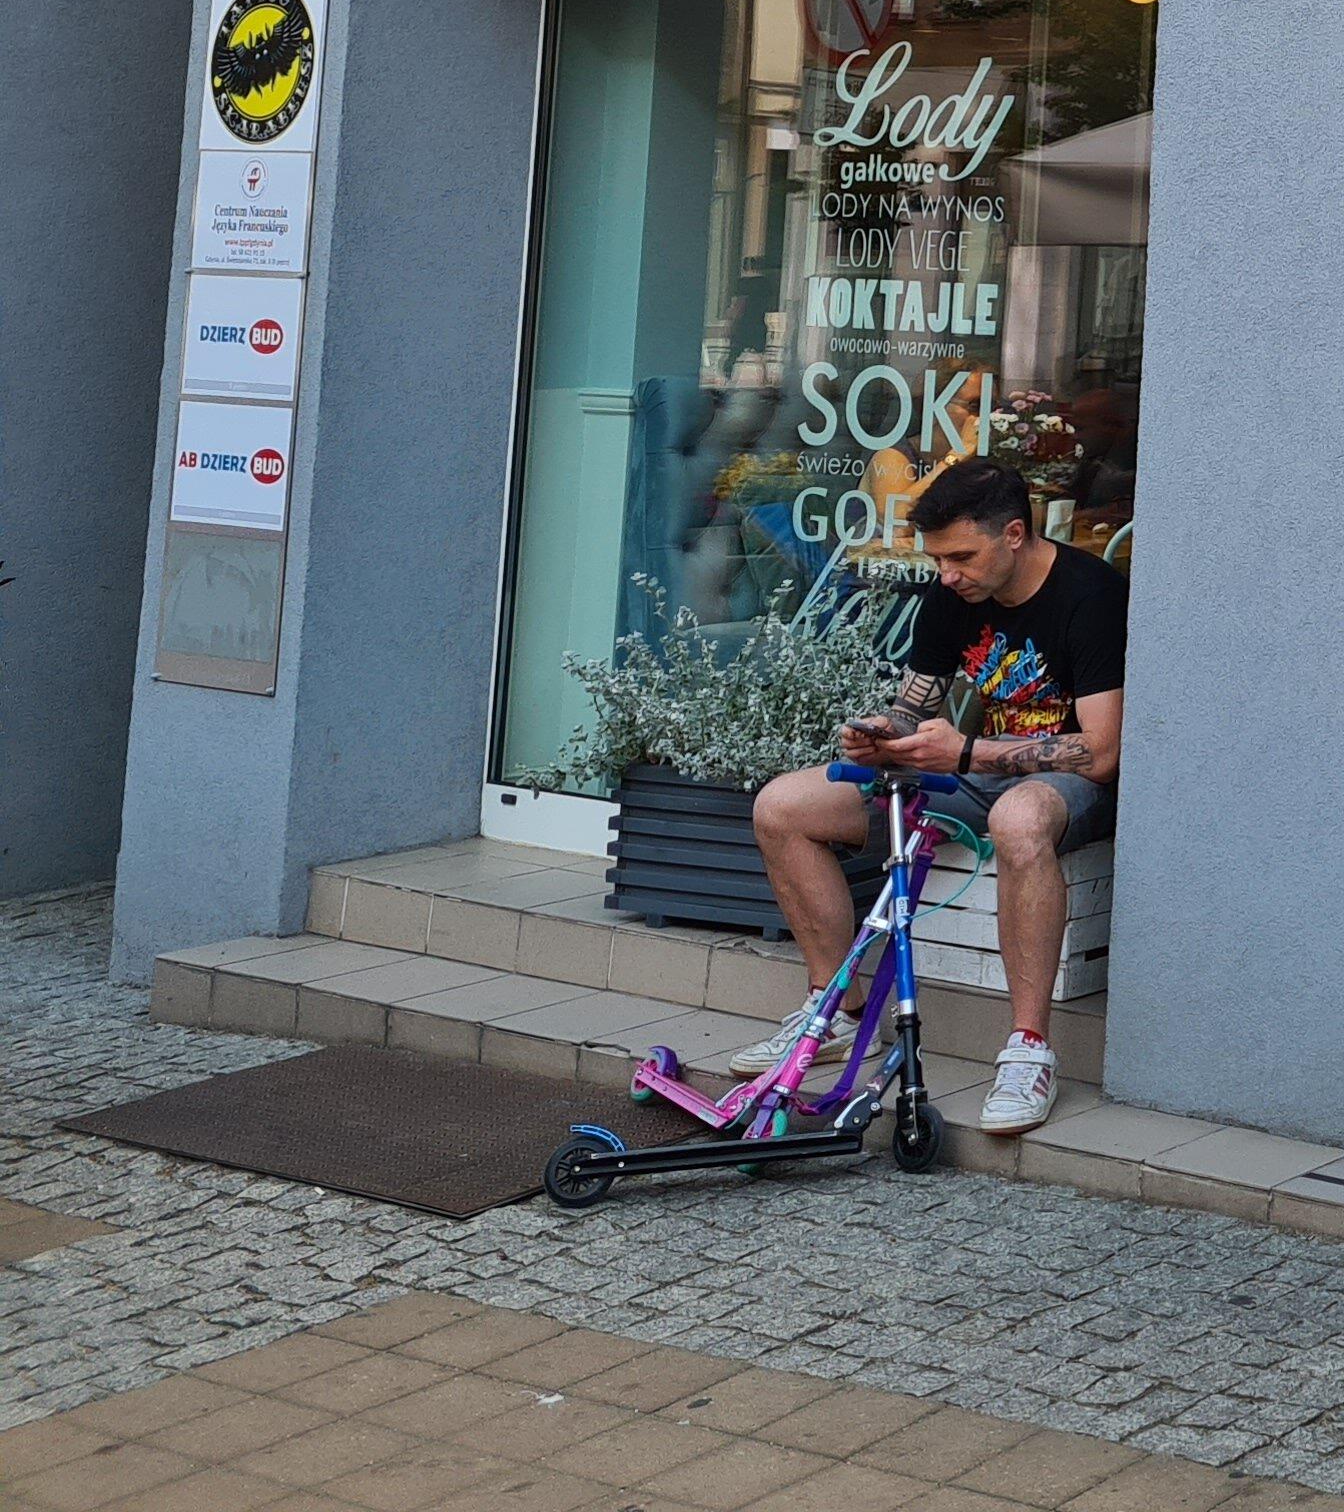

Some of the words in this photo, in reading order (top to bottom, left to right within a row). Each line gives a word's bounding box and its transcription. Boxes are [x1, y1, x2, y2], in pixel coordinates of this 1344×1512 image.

[812, 40, 1016, 182] Lody
[840, 154, 935, 189] gałkowe
[214, 204, 247, 218] Centrum
[249, 206, 289, 219] Nauczania
[812, 192, 872, 219] LODY
[879, 194, 911, 220] NA
[919, 195, 1005, 223] WYNOS
[212, 219, 237, 234] Języka
[238, 220, 289, 237] Francuskiego
[836, 228, 902, 269] LODY
[909, 230, 973, 272] VEGE
[806, 276, 999, 336] KOKTAJLE
[251, 327, 281, 346] BUD
[830, 337, 965, 362] owocowo-warzywne
[797, 361, 994, 457] SOKI
[179, 451, 197, 469] AB
[253, 458, 283, 476] BUD
[796, 451, 865, 477] świeżo
[792, 486, 924, 552] GOF
